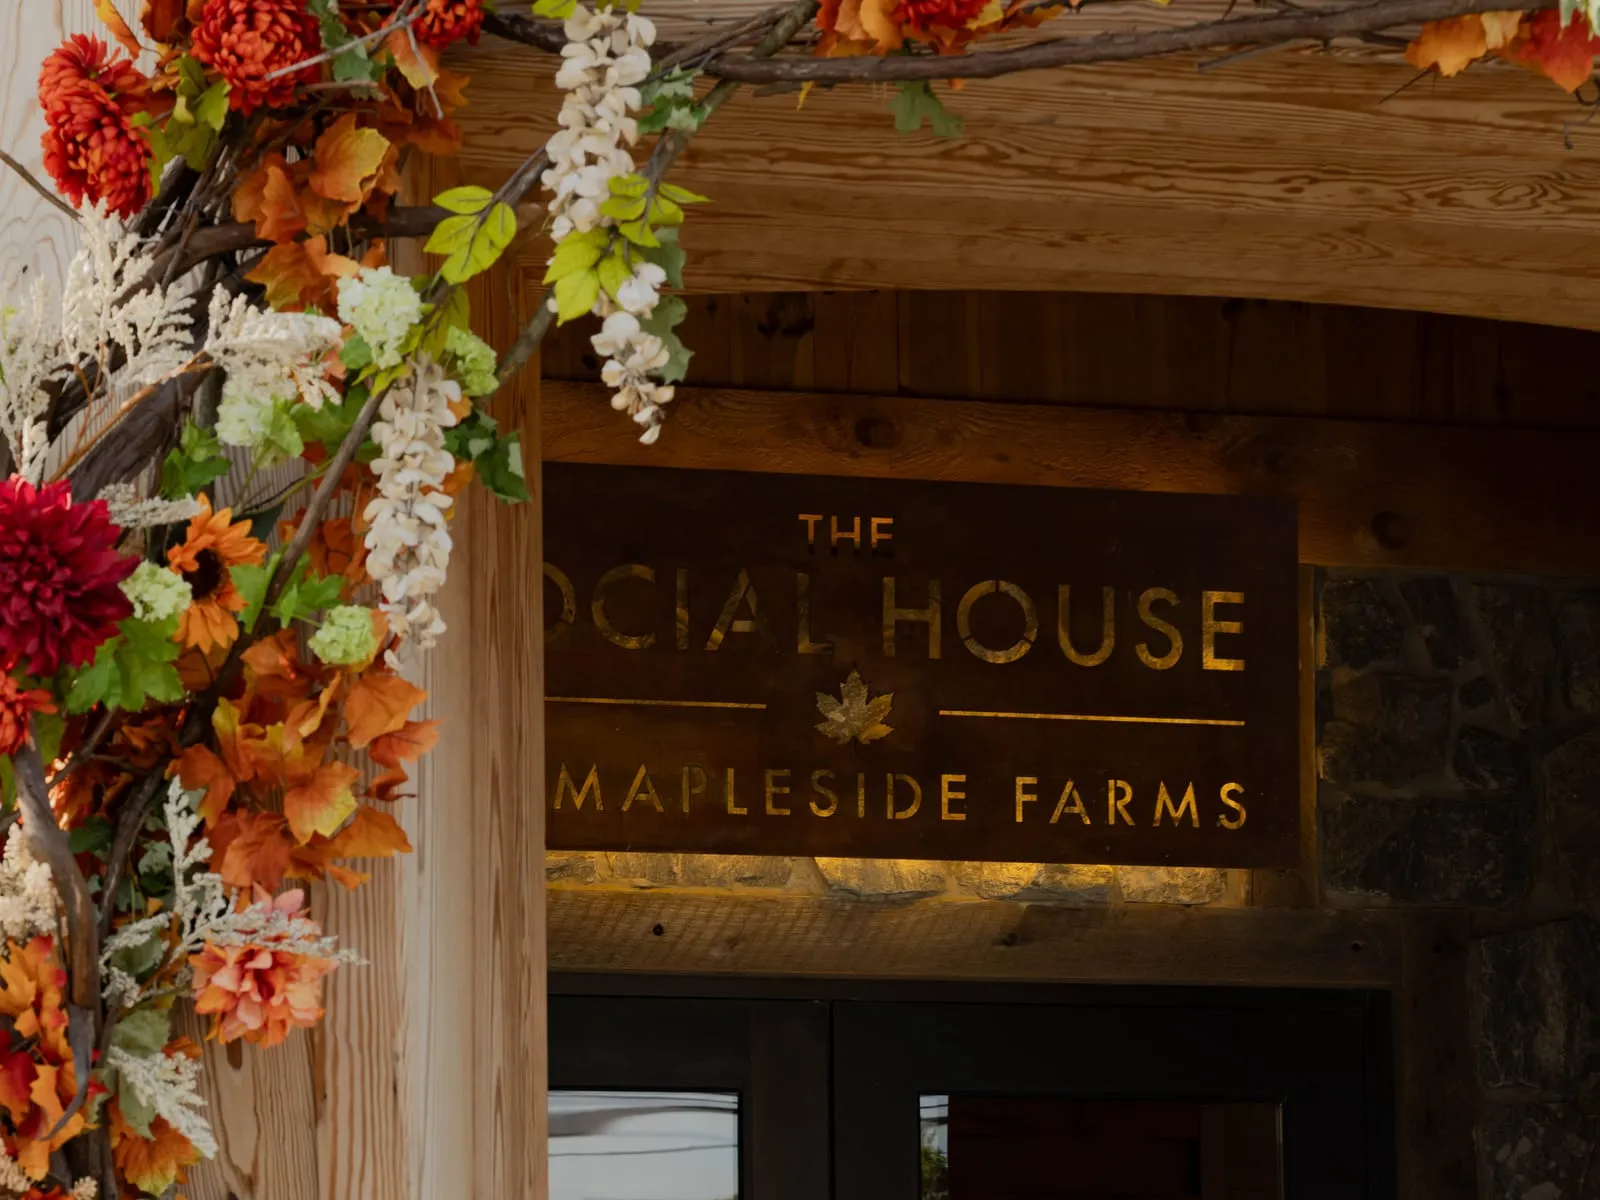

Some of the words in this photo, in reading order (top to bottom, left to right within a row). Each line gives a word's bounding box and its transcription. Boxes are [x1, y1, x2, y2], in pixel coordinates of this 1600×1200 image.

[797, 513, 894, 554] THE
[883, 576, 1245, 671] HOUSE
[553, 761, 967, 821] MAPLESIDE
[1015, 776, 1247, 829] FARMS
